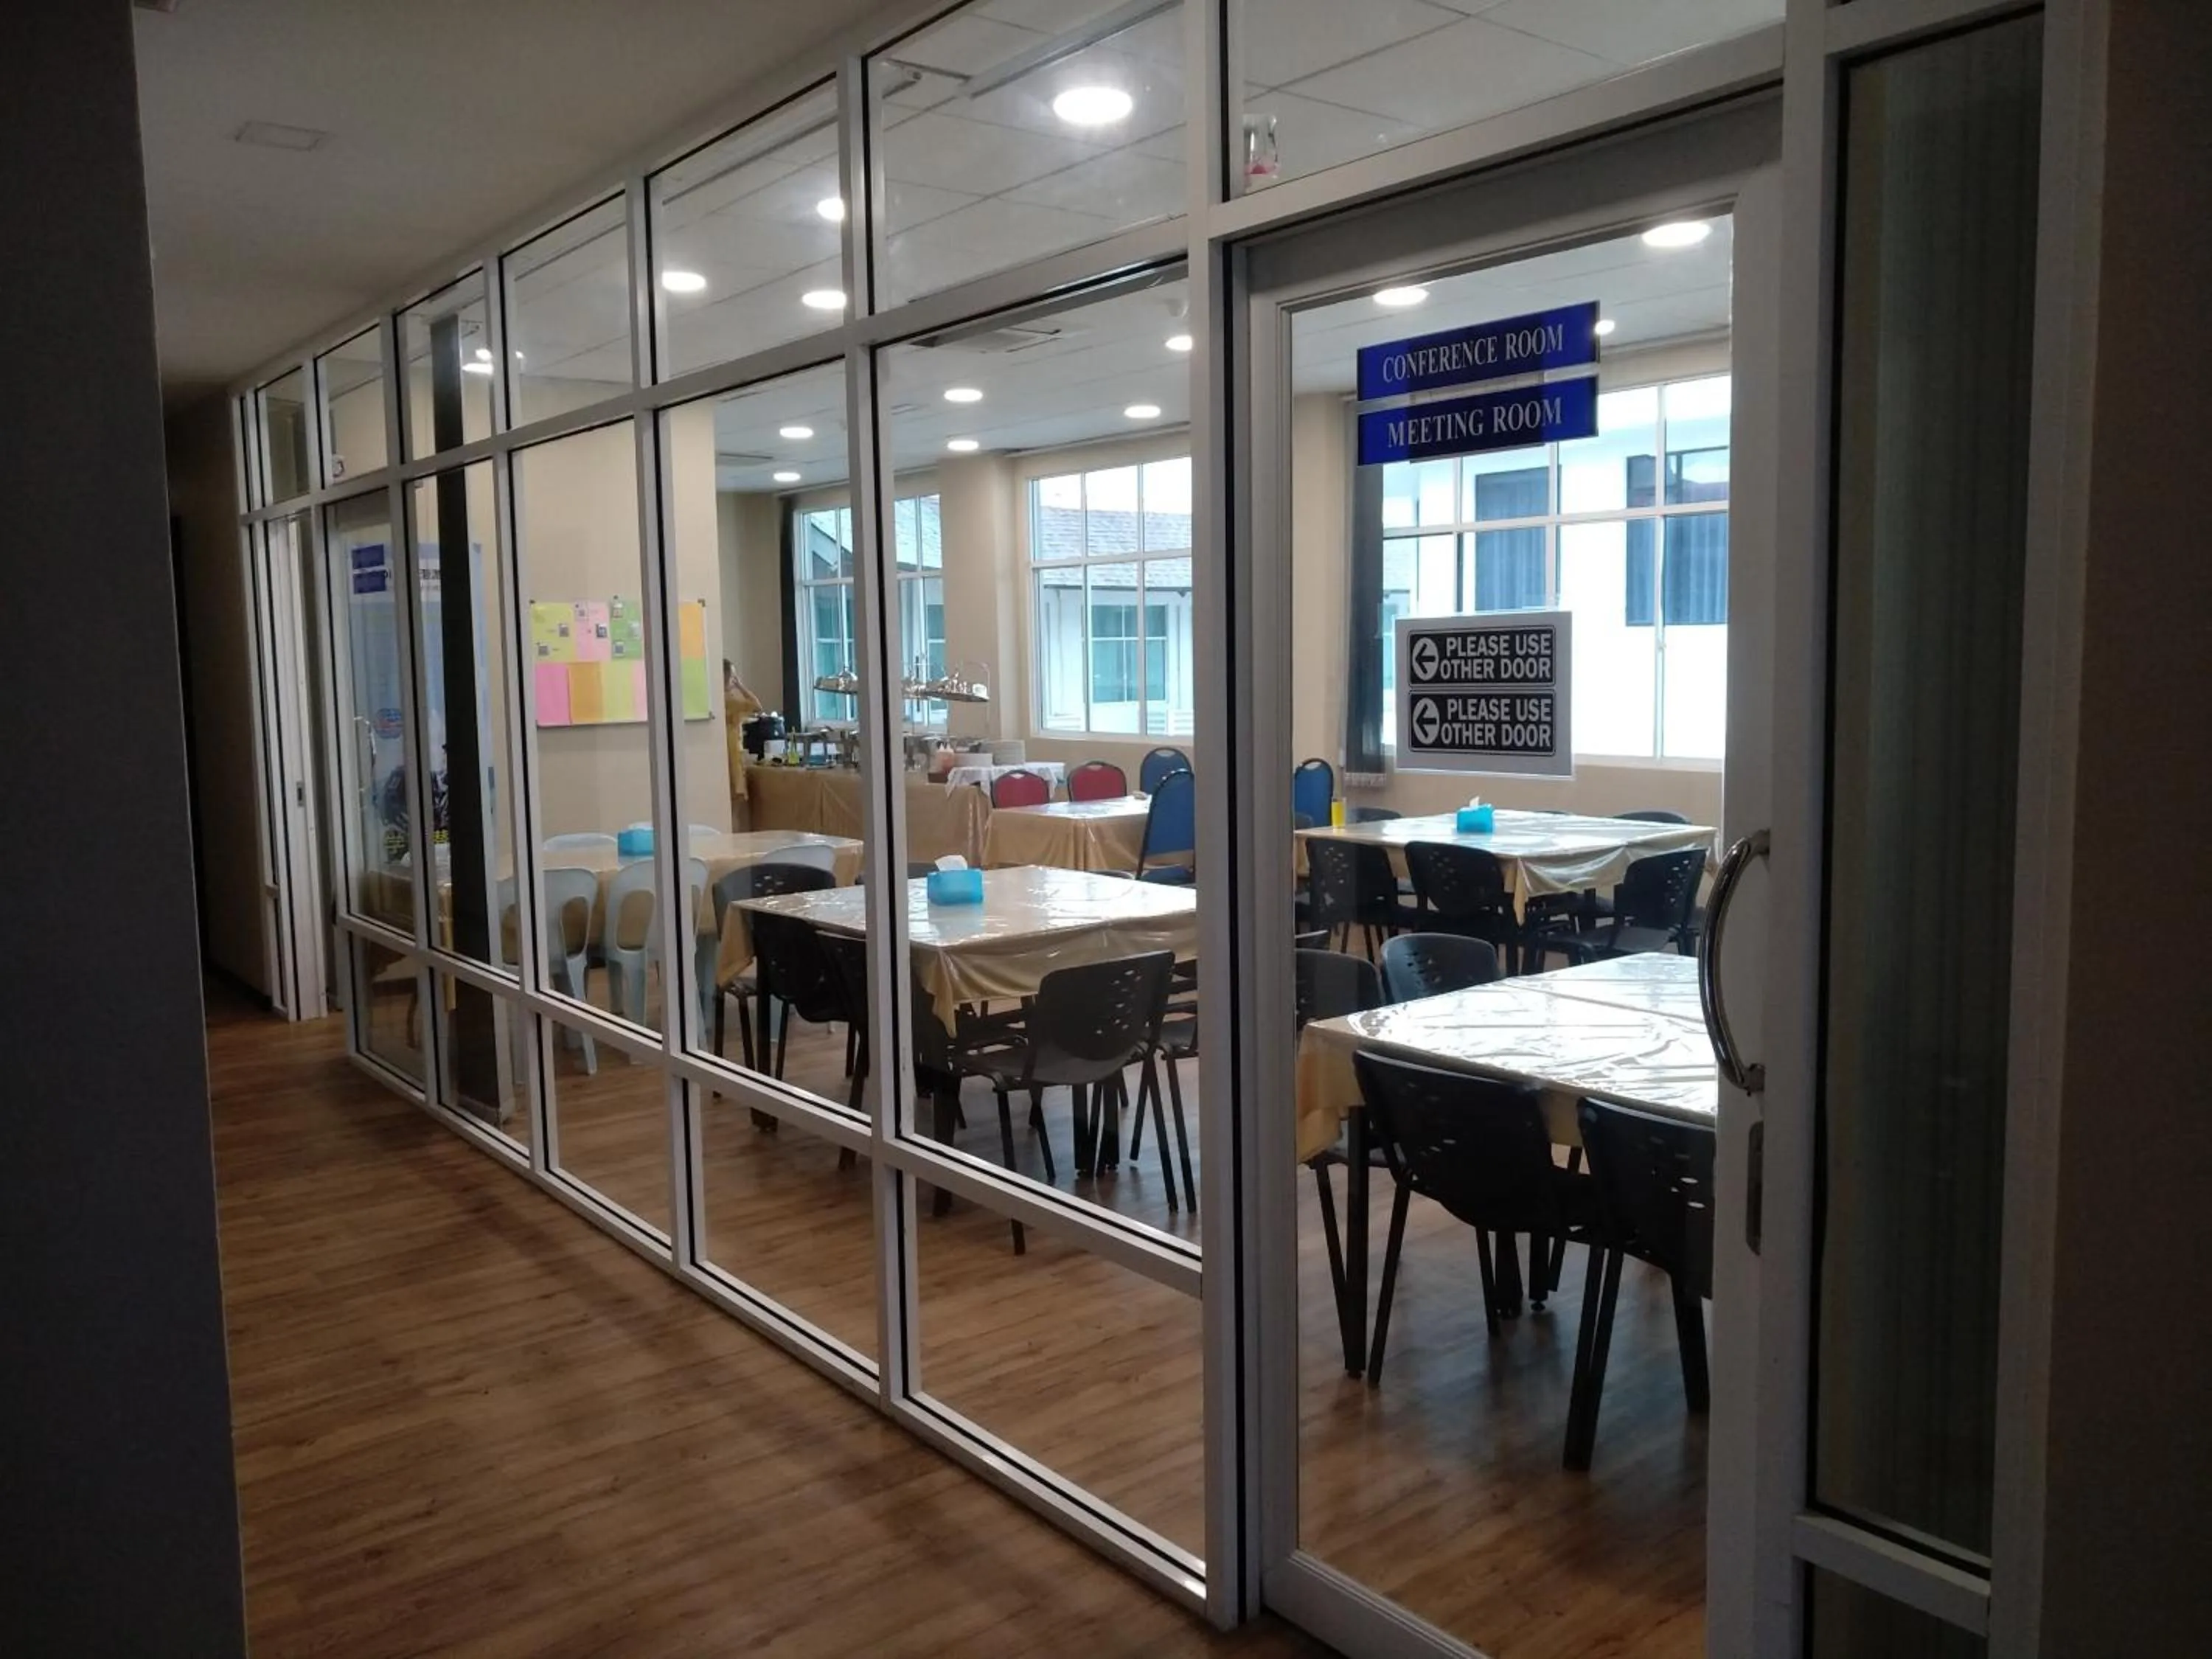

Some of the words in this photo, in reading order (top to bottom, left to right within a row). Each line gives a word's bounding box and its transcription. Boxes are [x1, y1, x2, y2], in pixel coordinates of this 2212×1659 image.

[1383, 336, 1498, 383] CONFERENCE
[1506, 324, 1564, 360] ROOM
[1388, 408, 1484, 448] MEETING
[1493, 397, 1562, 432] ROOM
[1446, 635, 1510, 657] PLEASE
[1515, 633, 1551, 655] USE
[1440, 658, 1495, 679] OTHER
[1500, 658, 1551, 678] DOOR
[1447, 698, 1511, 721] PLEASE
[1516, 698, 1552, 722] USE
[1441, 723, 1496, 745] OTHER
[1501, 723, 1551, 747] DOOR
